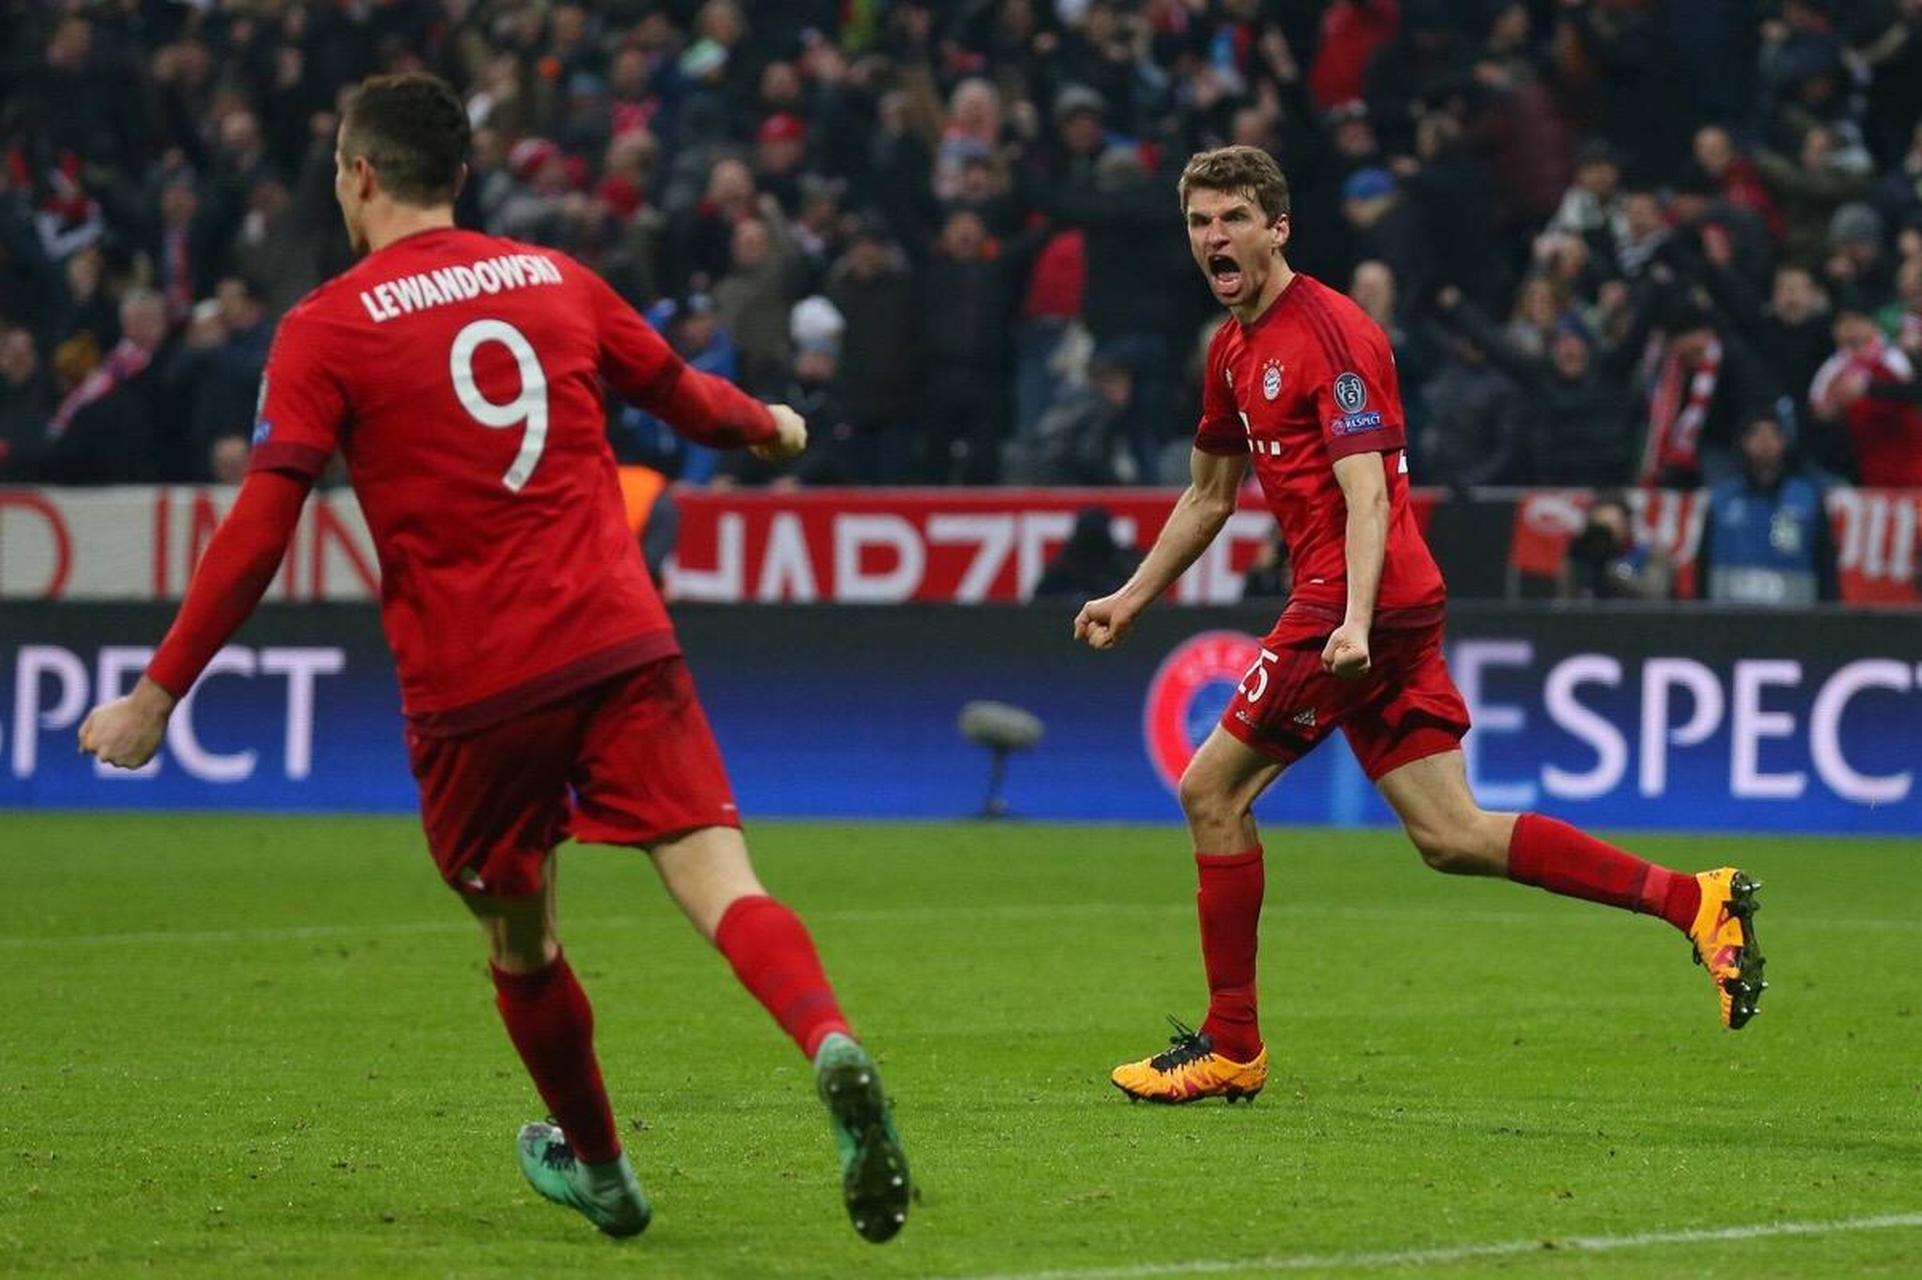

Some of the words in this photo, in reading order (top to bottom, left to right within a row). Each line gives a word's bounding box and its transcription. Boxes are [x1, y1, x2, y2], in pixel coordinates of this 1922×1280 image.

[360, 254, 564, 323] LEWANDOWSKI
[450, 318, 548, 494] 9
[0, 645, 346, 783] PECT
[1332, 640, 1922, 827] ESPEC
